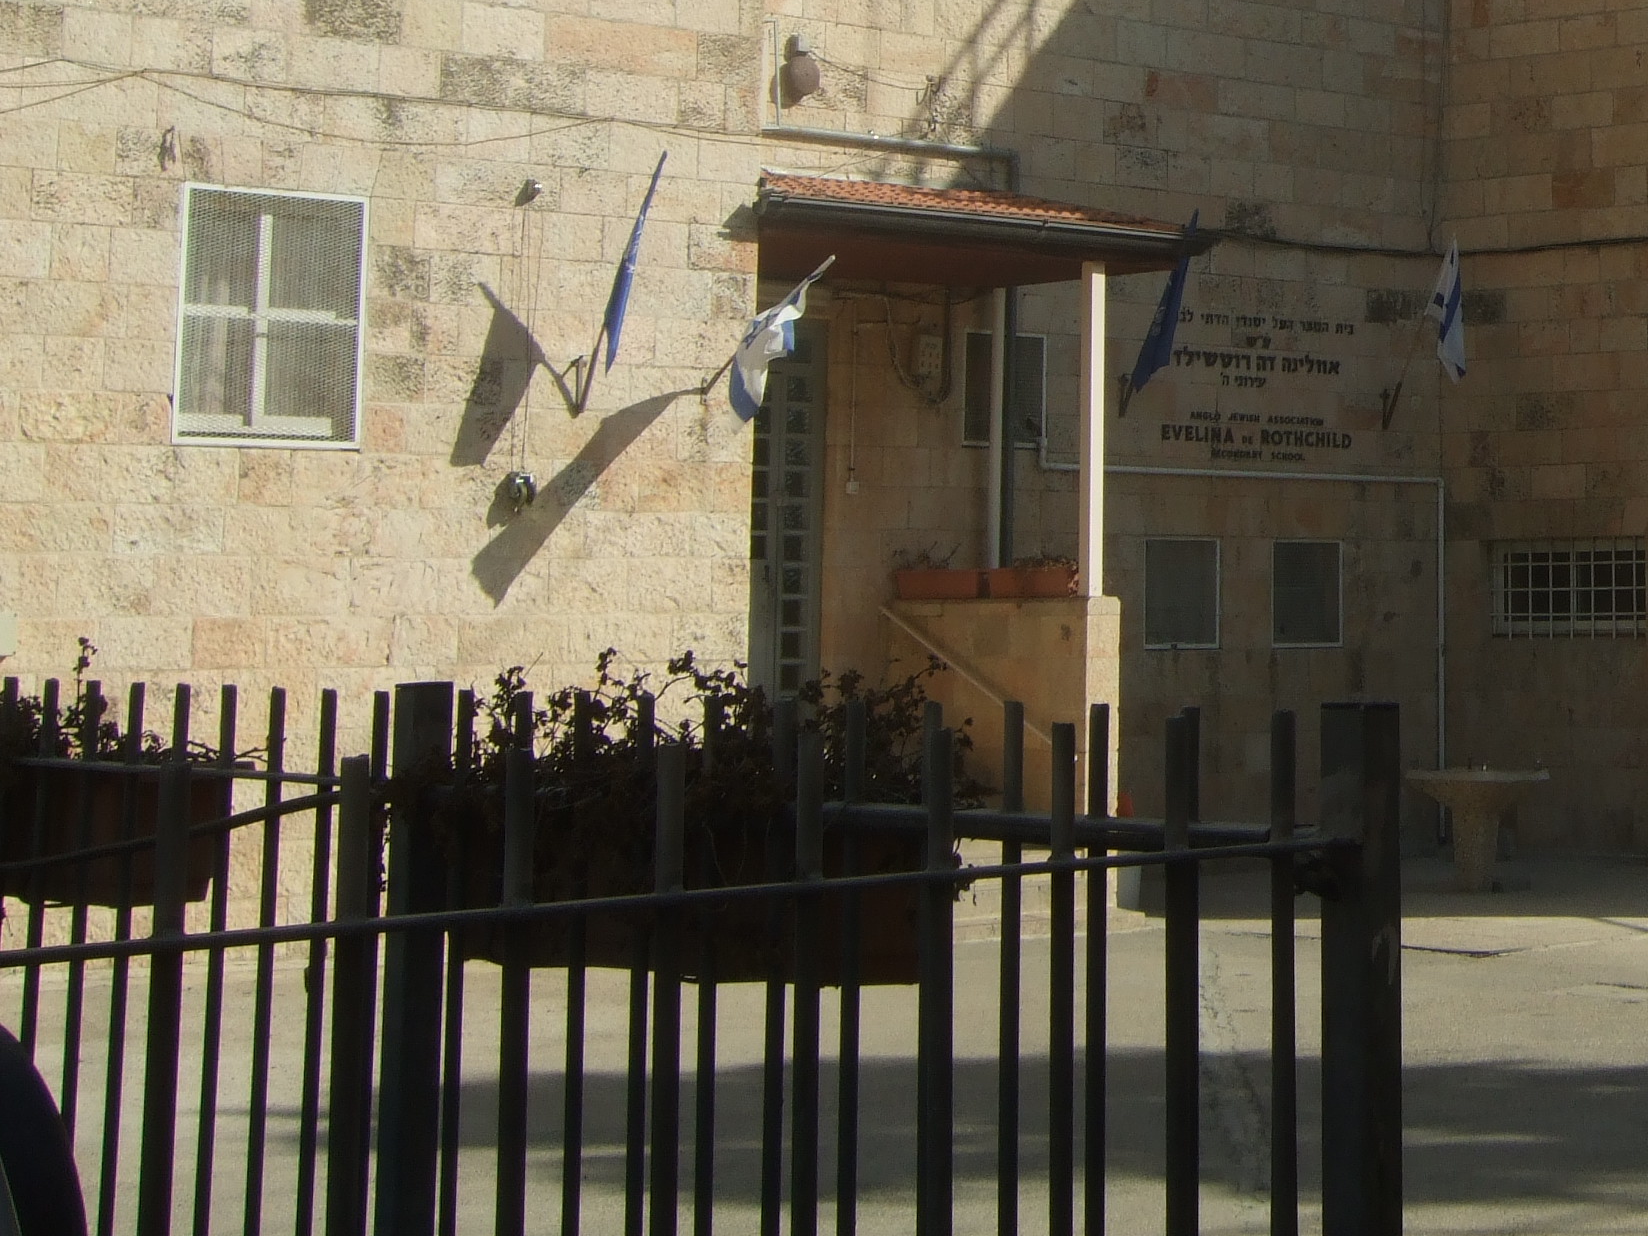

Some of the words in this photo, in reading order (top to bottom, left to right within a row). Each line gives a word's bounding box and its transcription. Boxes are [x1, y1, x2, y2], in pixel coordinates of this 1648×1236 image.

[1200, 313, 1230, 325] הדתי
[1335, 322, 1354, 335] בית
[1256, 355, 1276, 372] דה
[1282, 354, 1340, 375] אוולינה
[1190, 411, 1221, 422] ANGLO
[1228, 412, 1260, 423] JEWISH
[1267, 415, 1324, 426] ASSOCIATION
[1161, 424, 1234, 444] EVELINA
[1261, 429, 1352, 449] ROTHCHILD
[1271, 451, 1306, 462] SCHOOL
